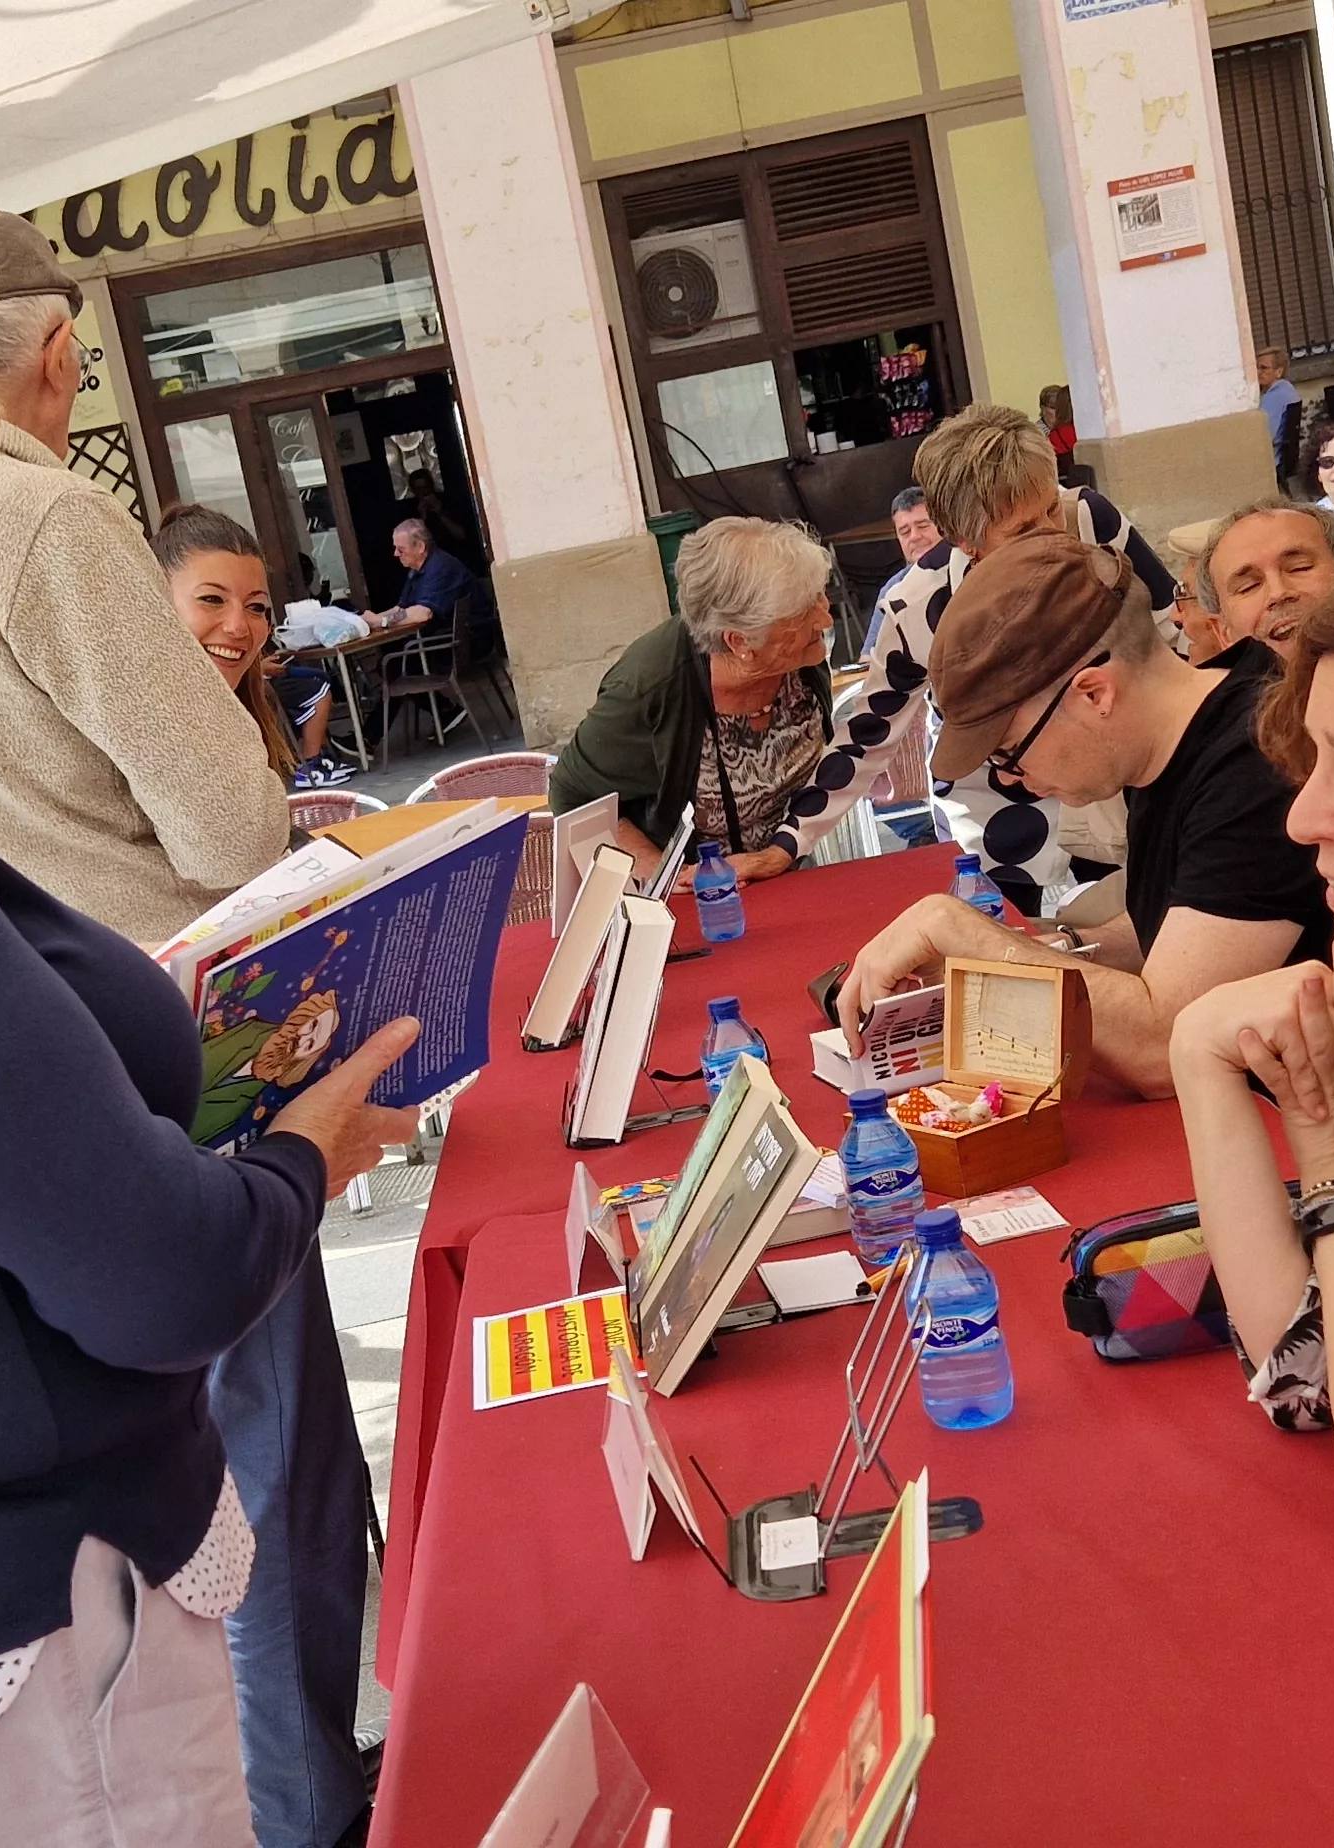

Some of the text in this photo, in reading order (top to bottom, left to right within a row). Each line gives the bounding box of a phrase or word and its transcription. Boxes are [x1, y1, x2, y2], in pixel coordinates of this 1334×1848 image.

[931, 1319, 963, 1329] MONTE
[936, 1326, 965, 1335] PINOS
[513, 1331, 542, 1376] ARAGÓN
